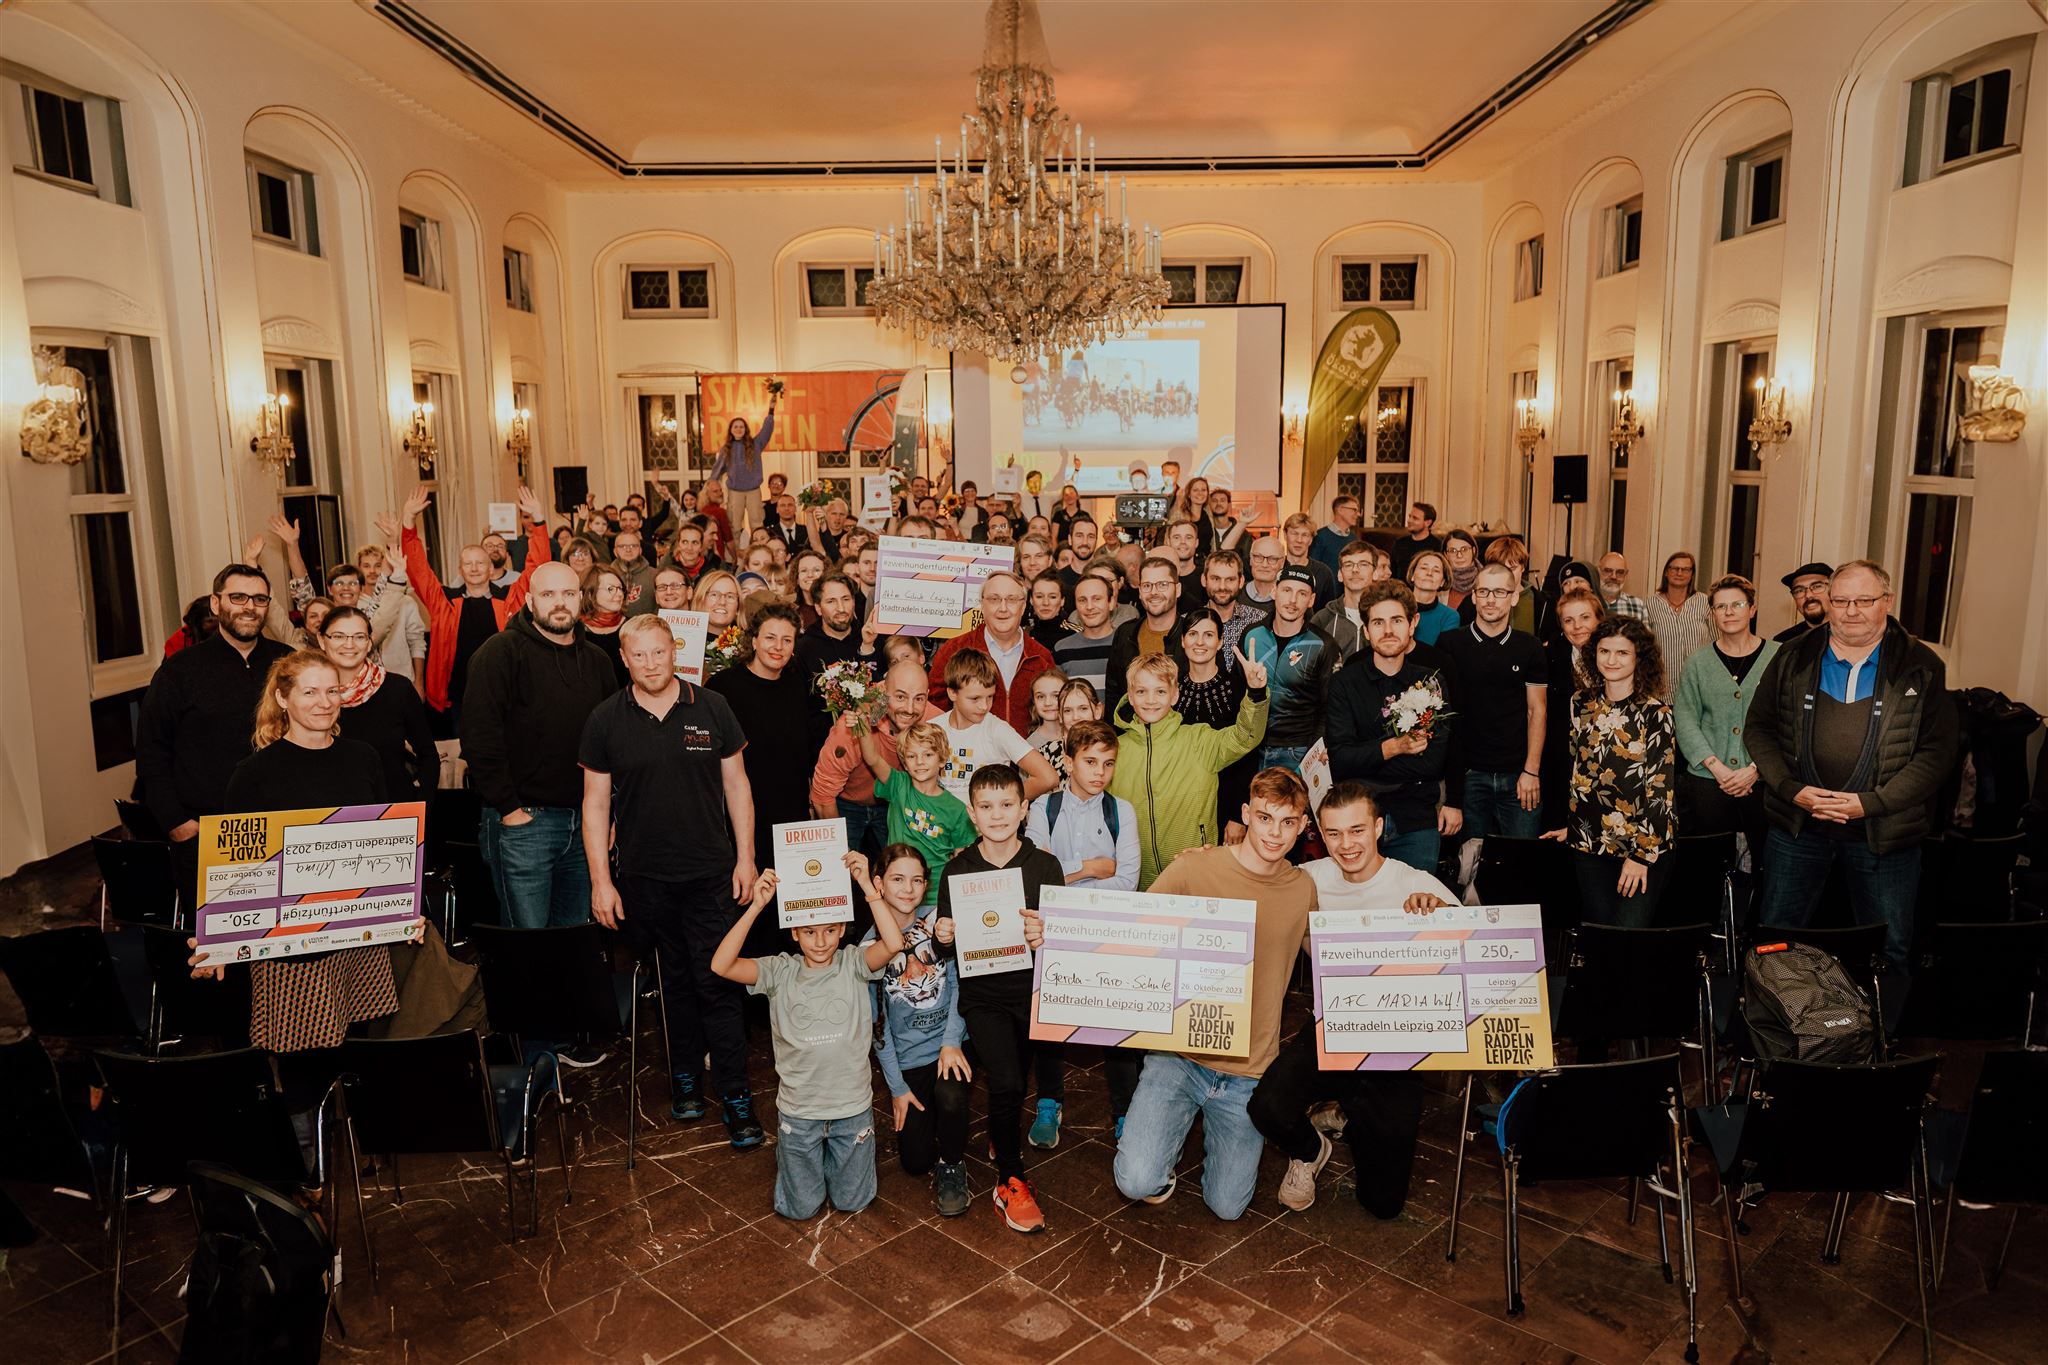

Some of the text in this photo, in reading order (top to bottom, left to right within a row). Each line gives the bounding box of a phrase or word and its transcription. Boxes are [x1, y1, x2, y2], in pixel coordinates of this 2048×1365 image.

[709, 413, 817, 451] RDELN
[881, 604, 962, 617] Stadtradeln Leipzig 2023
[220, 816, 267, 834] LEIPZIG
[217, 831, 267, 849] RADELN
[785, 827, 836, 844] URKUNDE
[219, 845, 267, 861] STADT-
[285, 836, 415, 856] Stadtradeln Leipzig 2023
[209, 869, 276, 882] 26. Oktober 2023
[228, 888, 257, 897] Leipzig
[962, 877, 1012, 895] URKUNDE
[282, 898, 414, 922] #zweihundertfünfzig#
[784, 896, 847, 911] STADTRADELN LEIPZIG
[222, 912, 262, 928] 250,-
[1046, 923, 1176, 943] #zweihundertfünfzig#
[1196, 934, 1232, 950] 250,-
[964, 945, 1026, 961] STADTRADELN LEIPZIG
[1320, 944, 1459, 960] #zweihundertfünfzig#
[1480, 944, 1520, 959] 250,-
[1199, 966, 1226, 975] Leipzig
[1181, 983, 1243, 995] 26. Oktober 2023
[1488, 978, 1517, 987] Leipzig
[1043, 993, 1172, 1013] Stadtradeln Leipzig 2023
[1377, 993, 1428, 1009] MARIA
[1484, 997, 1516, 1006] Oktober
[1519, 996, 1538, 1005] 2023
[1189, 1002, 1233, 1019] STADT-
[1189, 1018, 1234, 1036] RADELN
[1326, 1020, 1464, 1033] Stadtradeln Leipzig 2023
[1483, 1017, 1530, 1033] STADT-
[804, 1032, 843, 1042] AMSTERDAM
[1188, 1033, 1232, 1050] LEIPZIG
[1484, 1033, 1535, 1049] RADELN
[1486, 1048, 1534, 1065] LEIPZIG
